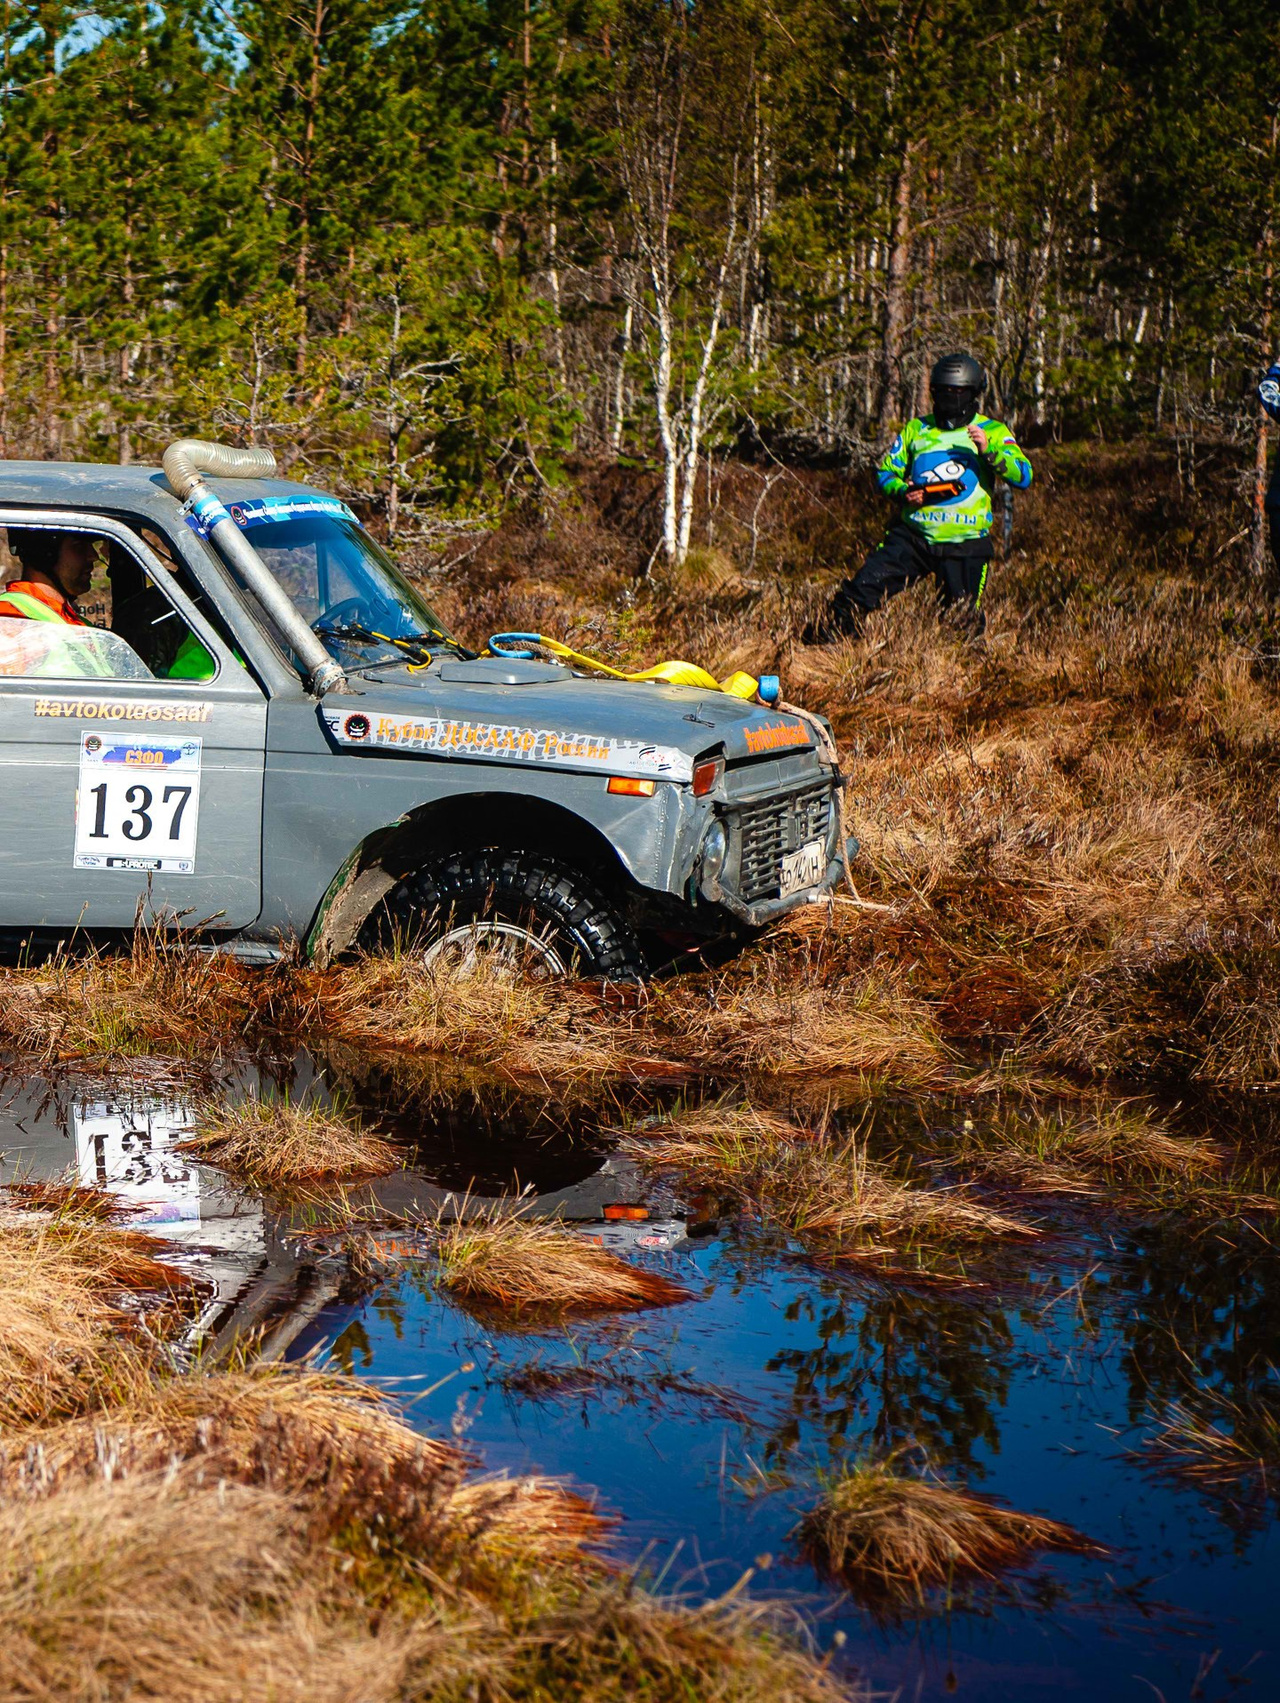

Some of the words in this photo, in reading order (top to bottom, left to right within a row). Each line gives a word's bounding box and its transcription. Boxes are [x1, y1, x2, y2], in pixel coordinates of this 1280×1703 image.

[377, 718, 437, 742] Кубок
[441, 723, 536, 752] ДОСААФ
[543, 734, 611, 760] России
[89, 783, 192, 841] 137
